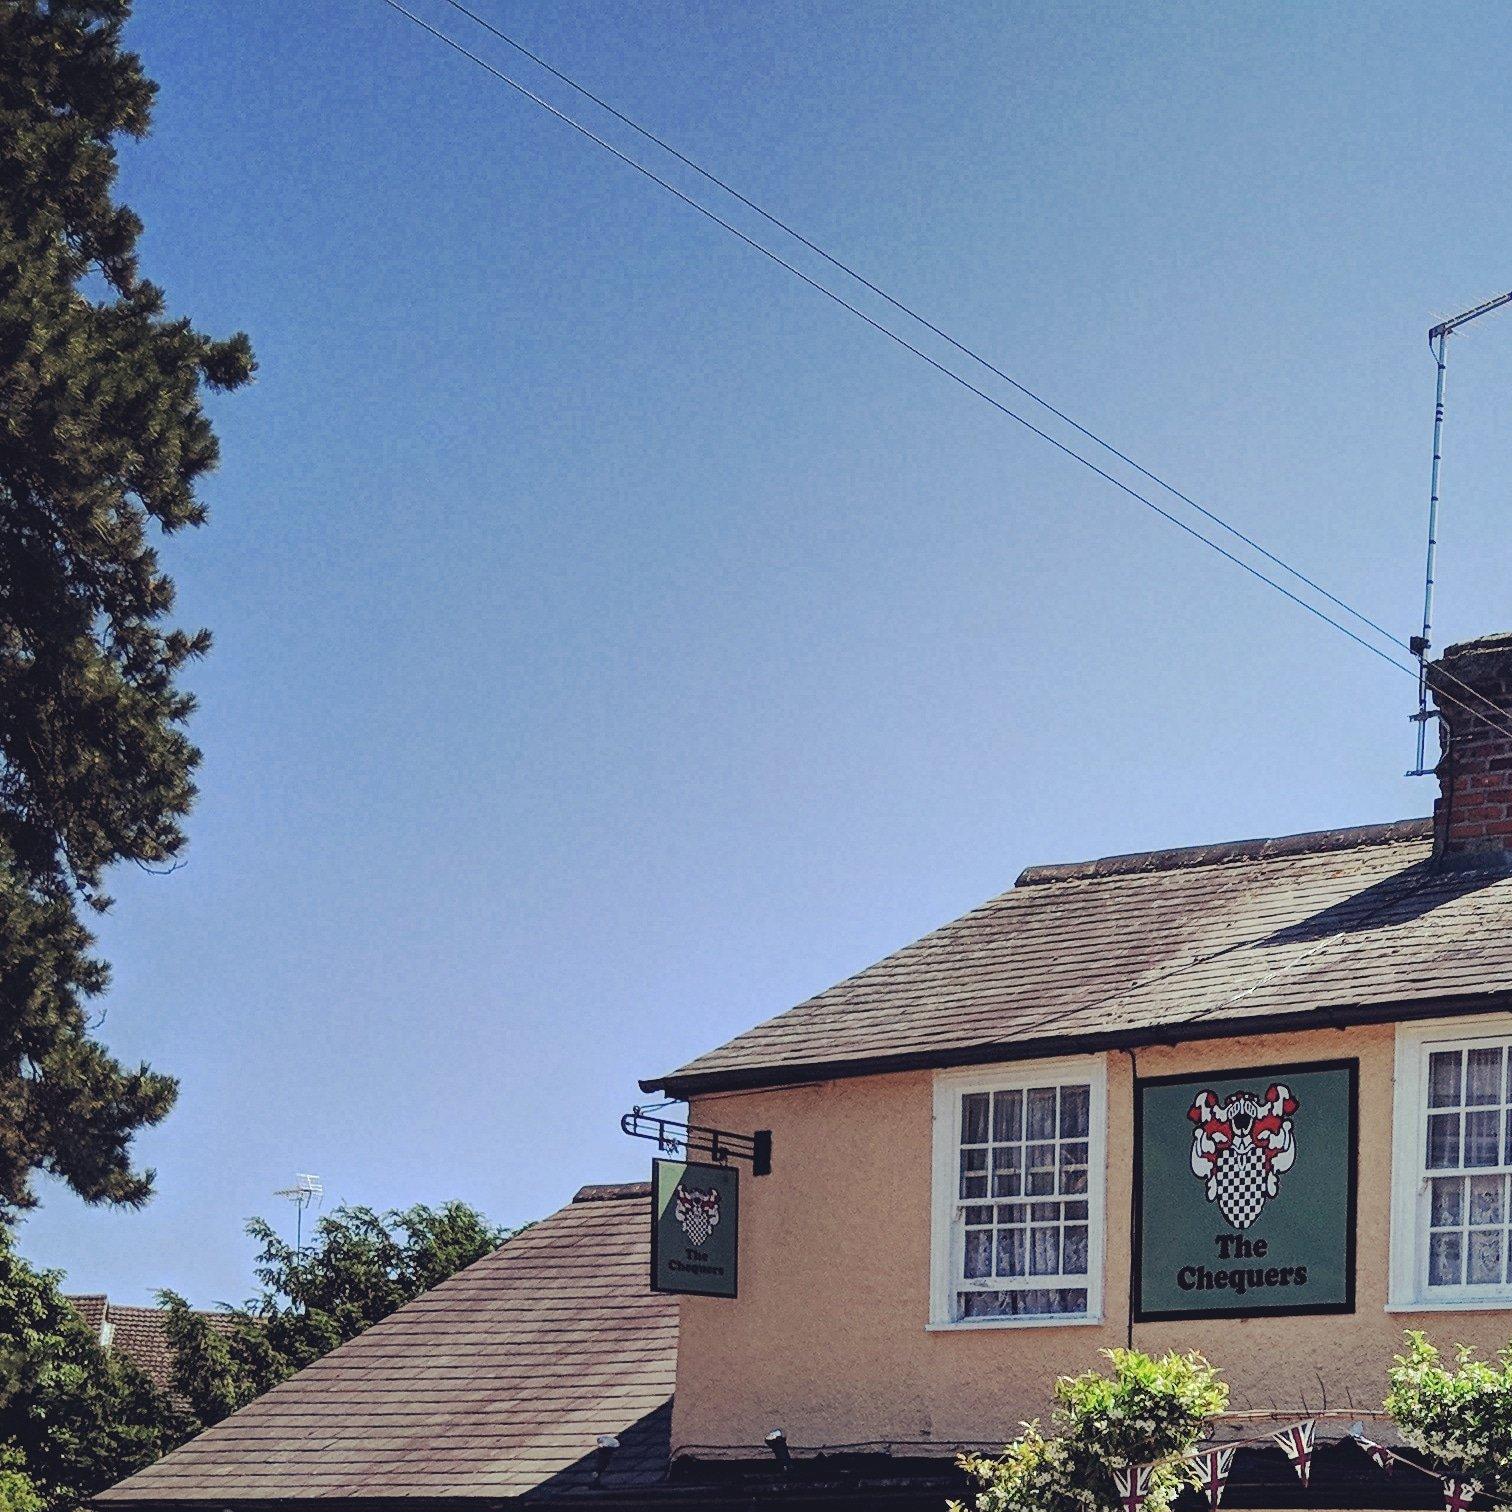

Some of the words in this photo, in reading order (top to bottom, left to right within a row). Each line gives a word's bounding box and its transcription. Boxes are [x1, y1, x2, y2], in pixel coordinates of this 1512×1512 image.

[685, 1248, 708, 1262] The
[1215, 1233, 1268, 1260] The
[668, 1259, 725, 1276] Chequers
[1177, 1265, 1308, 1295] Chequers
